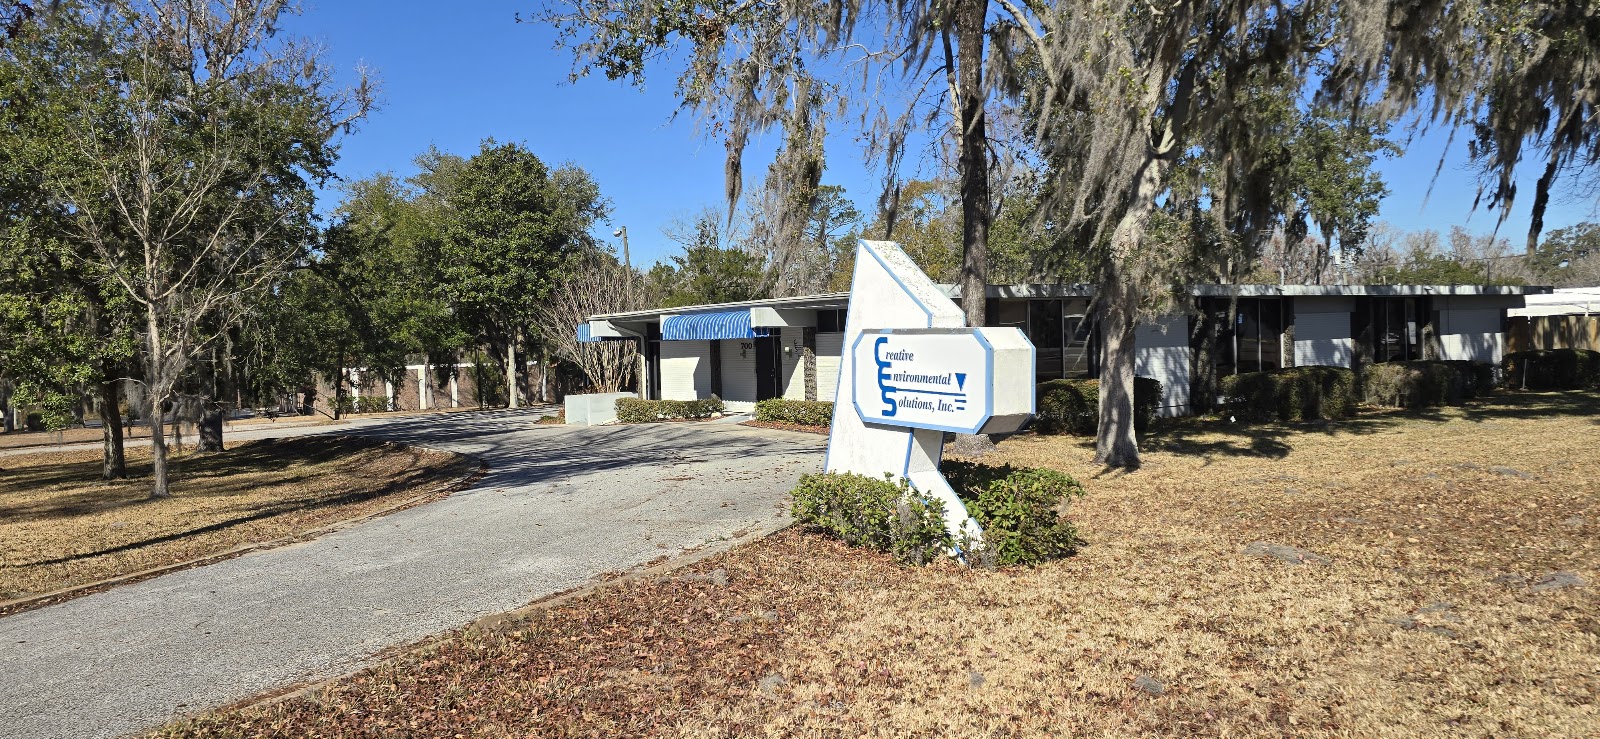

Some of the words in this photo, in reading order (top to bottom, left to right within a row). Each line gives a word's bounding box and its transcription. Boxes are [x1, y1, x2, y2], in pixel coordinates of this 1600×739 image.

[874, 337, 914, 365] Creative
[878, 361, 951, 391] Environmental
[882, 386, 935, 416] Solutions,
[937, 399, 954, 413] Inc.
